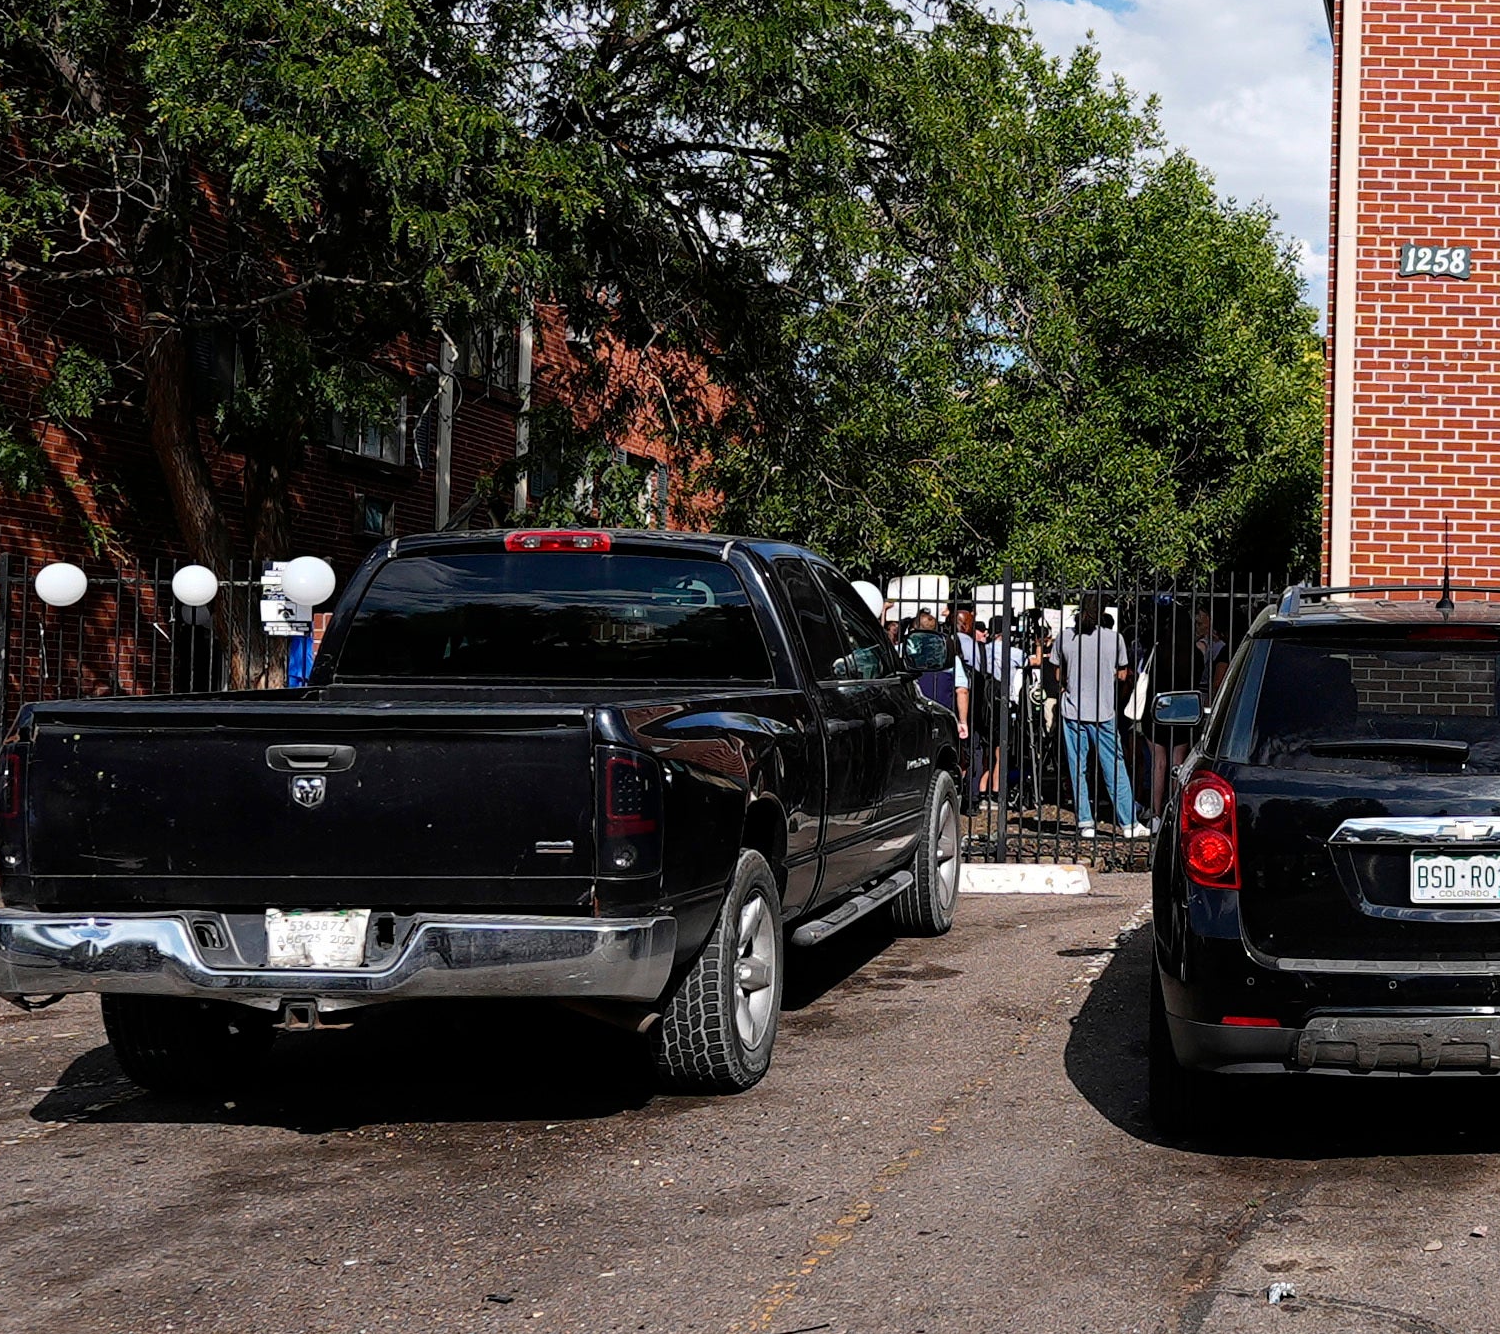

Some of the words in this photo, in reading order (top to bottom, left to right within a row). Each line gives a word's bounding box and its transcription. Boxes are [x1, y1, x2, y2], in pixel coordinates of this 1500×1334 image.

[1405, 247, 1467, 274] 1258
[1438, 889, 1490, 898] COLORADO
[289, 920, 347, 932] 5363872
